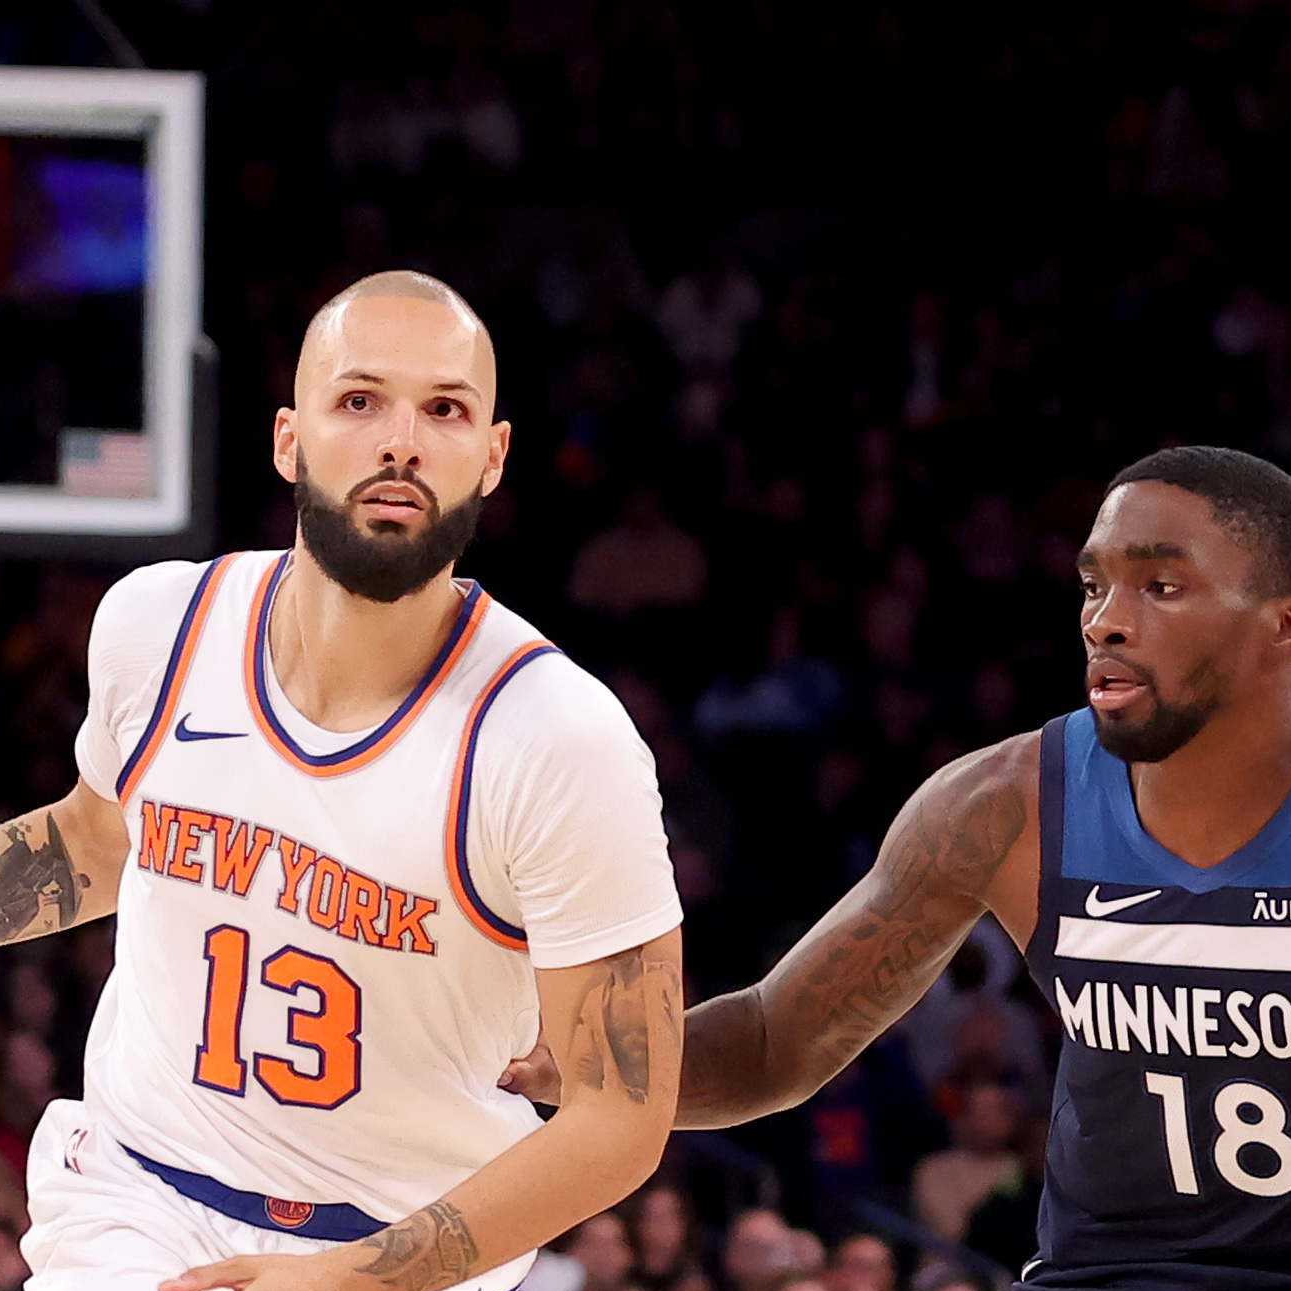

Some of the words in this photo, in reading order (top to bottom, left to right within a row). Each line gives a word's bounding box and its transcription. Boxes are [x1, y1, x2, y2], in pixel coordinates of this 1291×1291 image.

[138, 800, 273, 897] NEW
[277, 834, 438, 956] YORK
[192, 923, 362, 1111] 13
